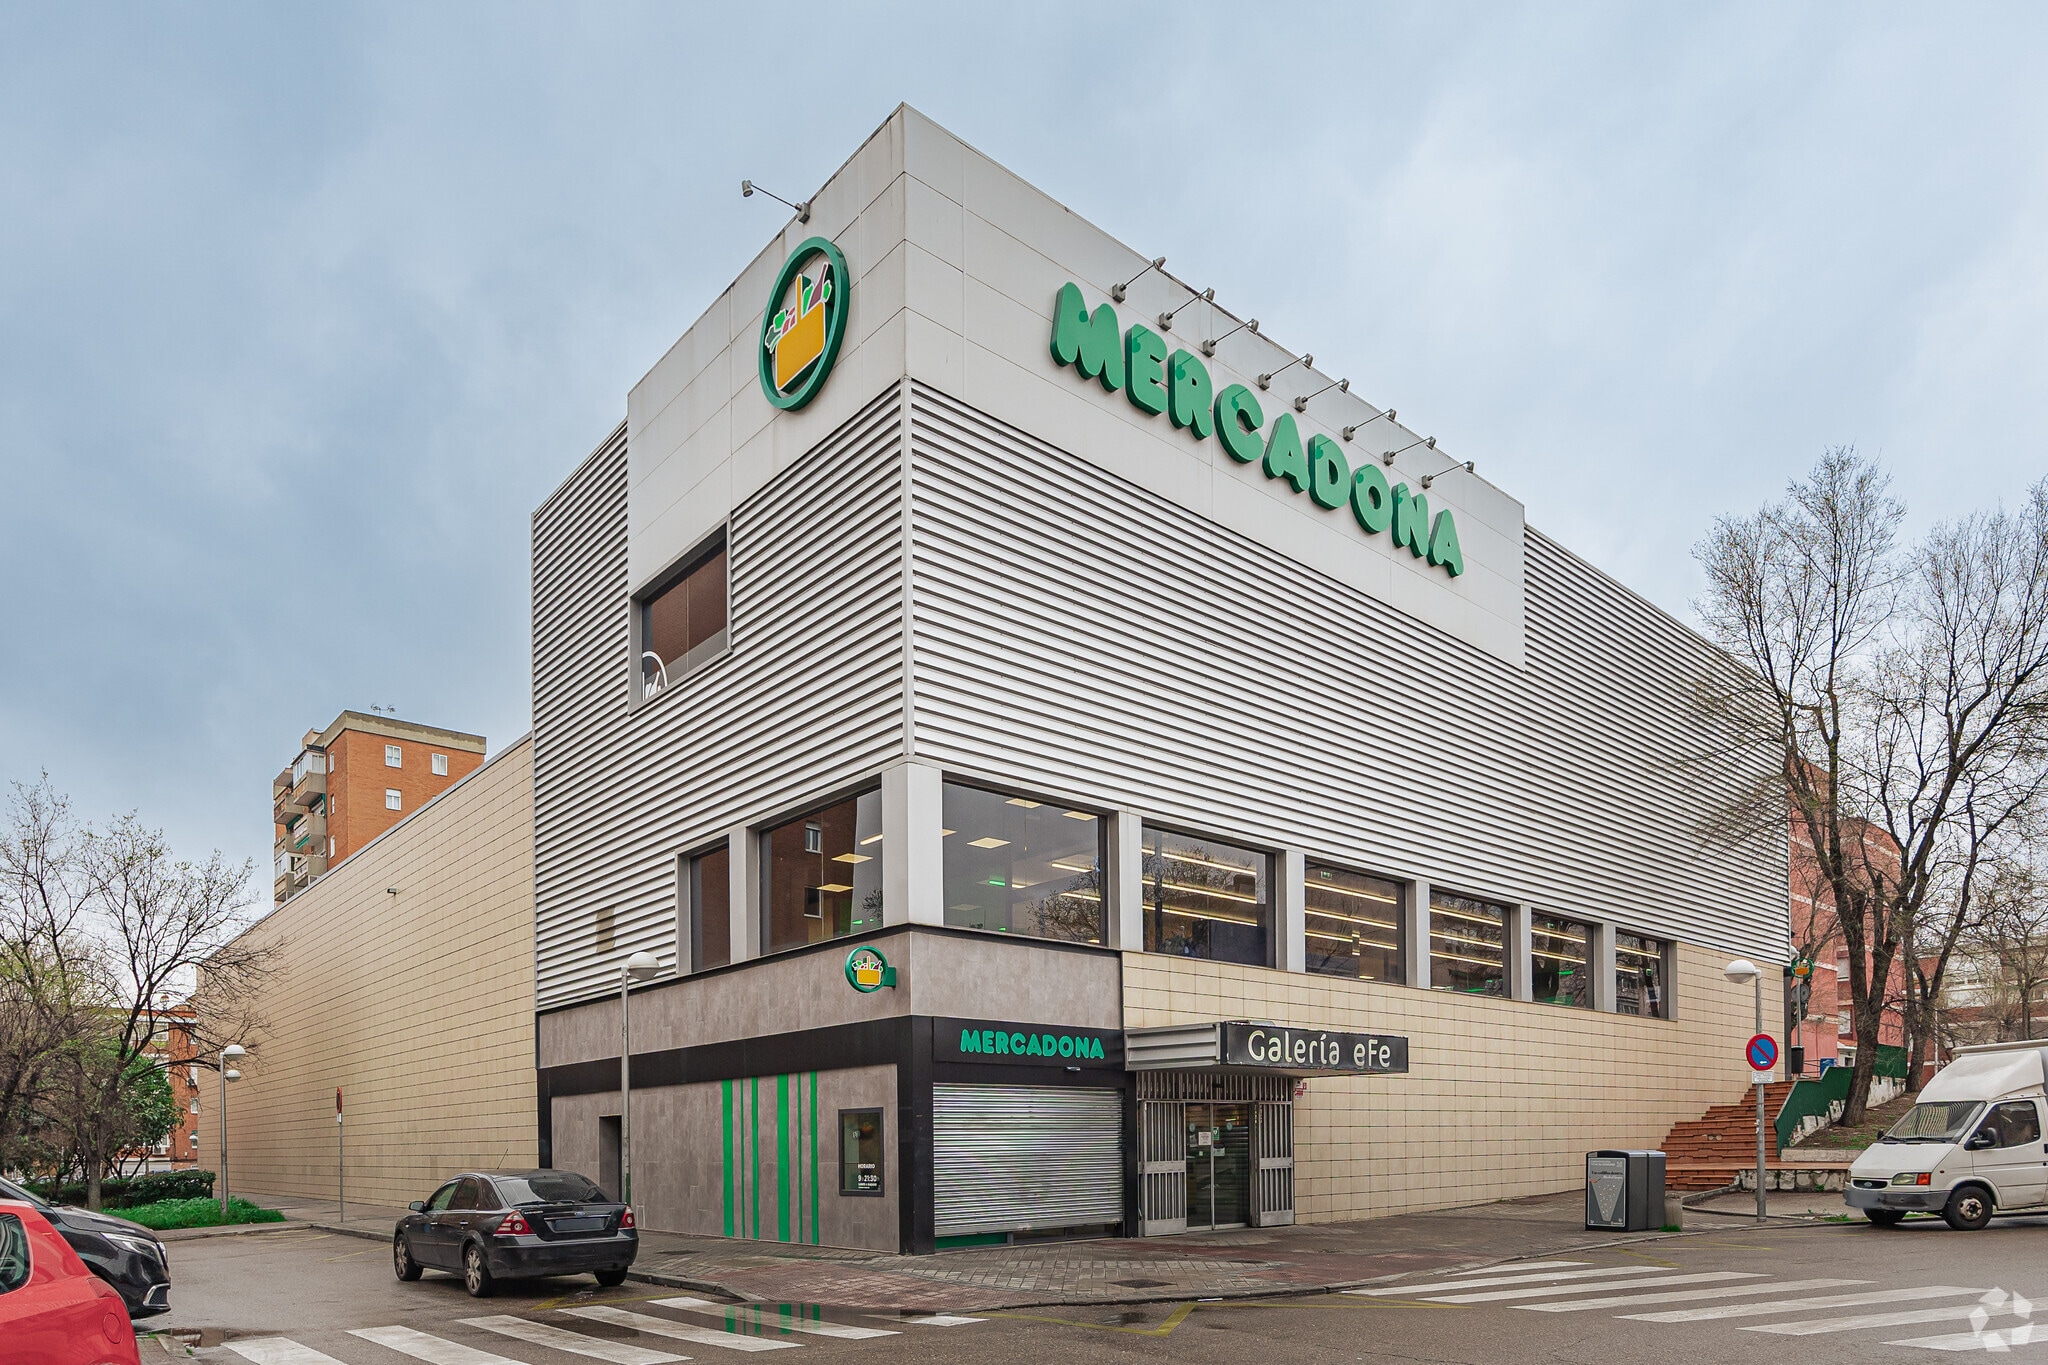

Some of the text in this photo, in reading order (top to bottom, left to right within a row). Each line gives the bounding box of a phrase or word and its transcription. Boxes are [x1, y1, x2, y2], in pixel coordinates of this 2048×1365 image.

[1050, 281, 1465, 578] MERCADONA
[959, 1027, 1105, 1060] MERCADONA
[1247, 1029, 1340, 1065] Galería
